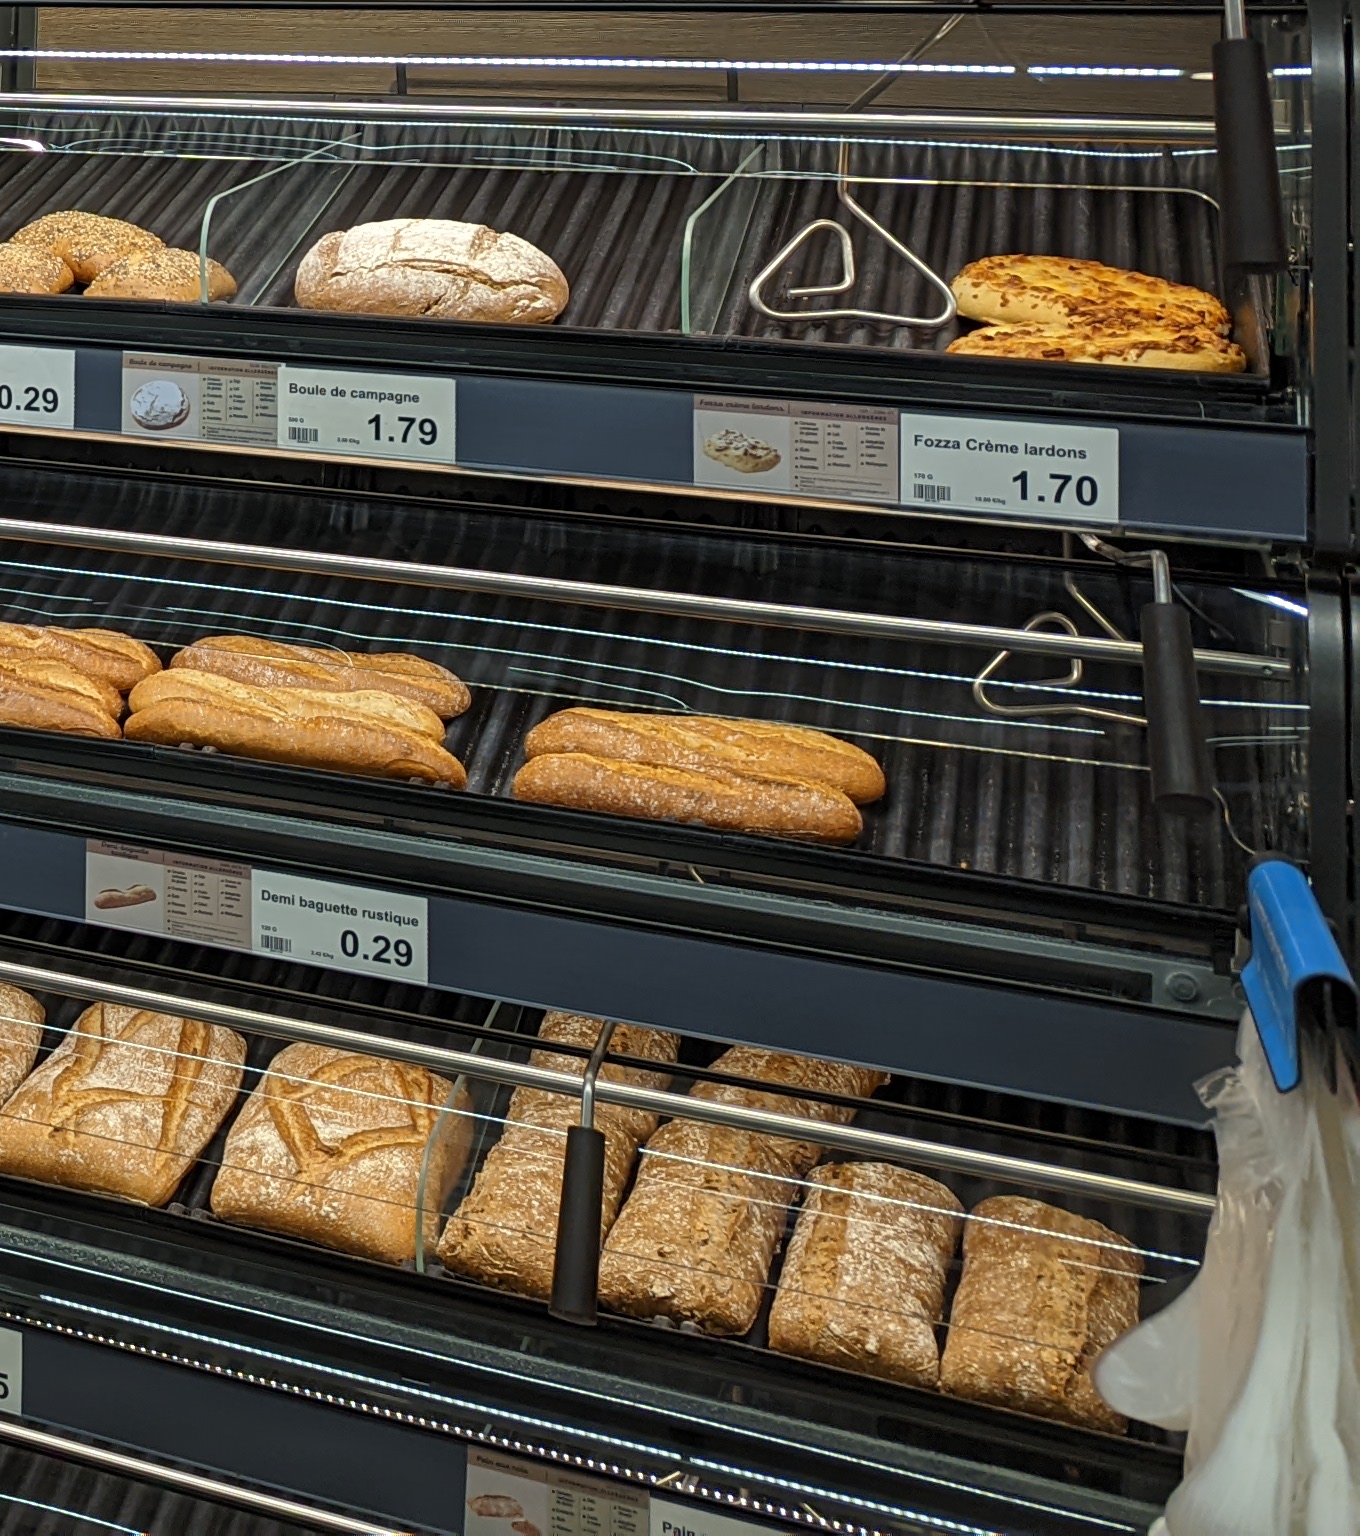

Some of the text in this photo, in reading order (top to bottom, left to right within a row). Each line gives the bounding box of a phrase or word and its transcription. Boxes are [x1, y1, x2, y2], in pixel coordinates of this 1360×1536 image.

[289, 382, 420, 404] Boule de campagne
[367, 414, 438, 445] 1.79
[914, 434, 1087, 459] Fozza Crème lardons
[1012, 470, 1099, 507] 1.70
[261, 888, 420, 928] Demi baguette rustique
[339, 928, 414, 968] 0.29
